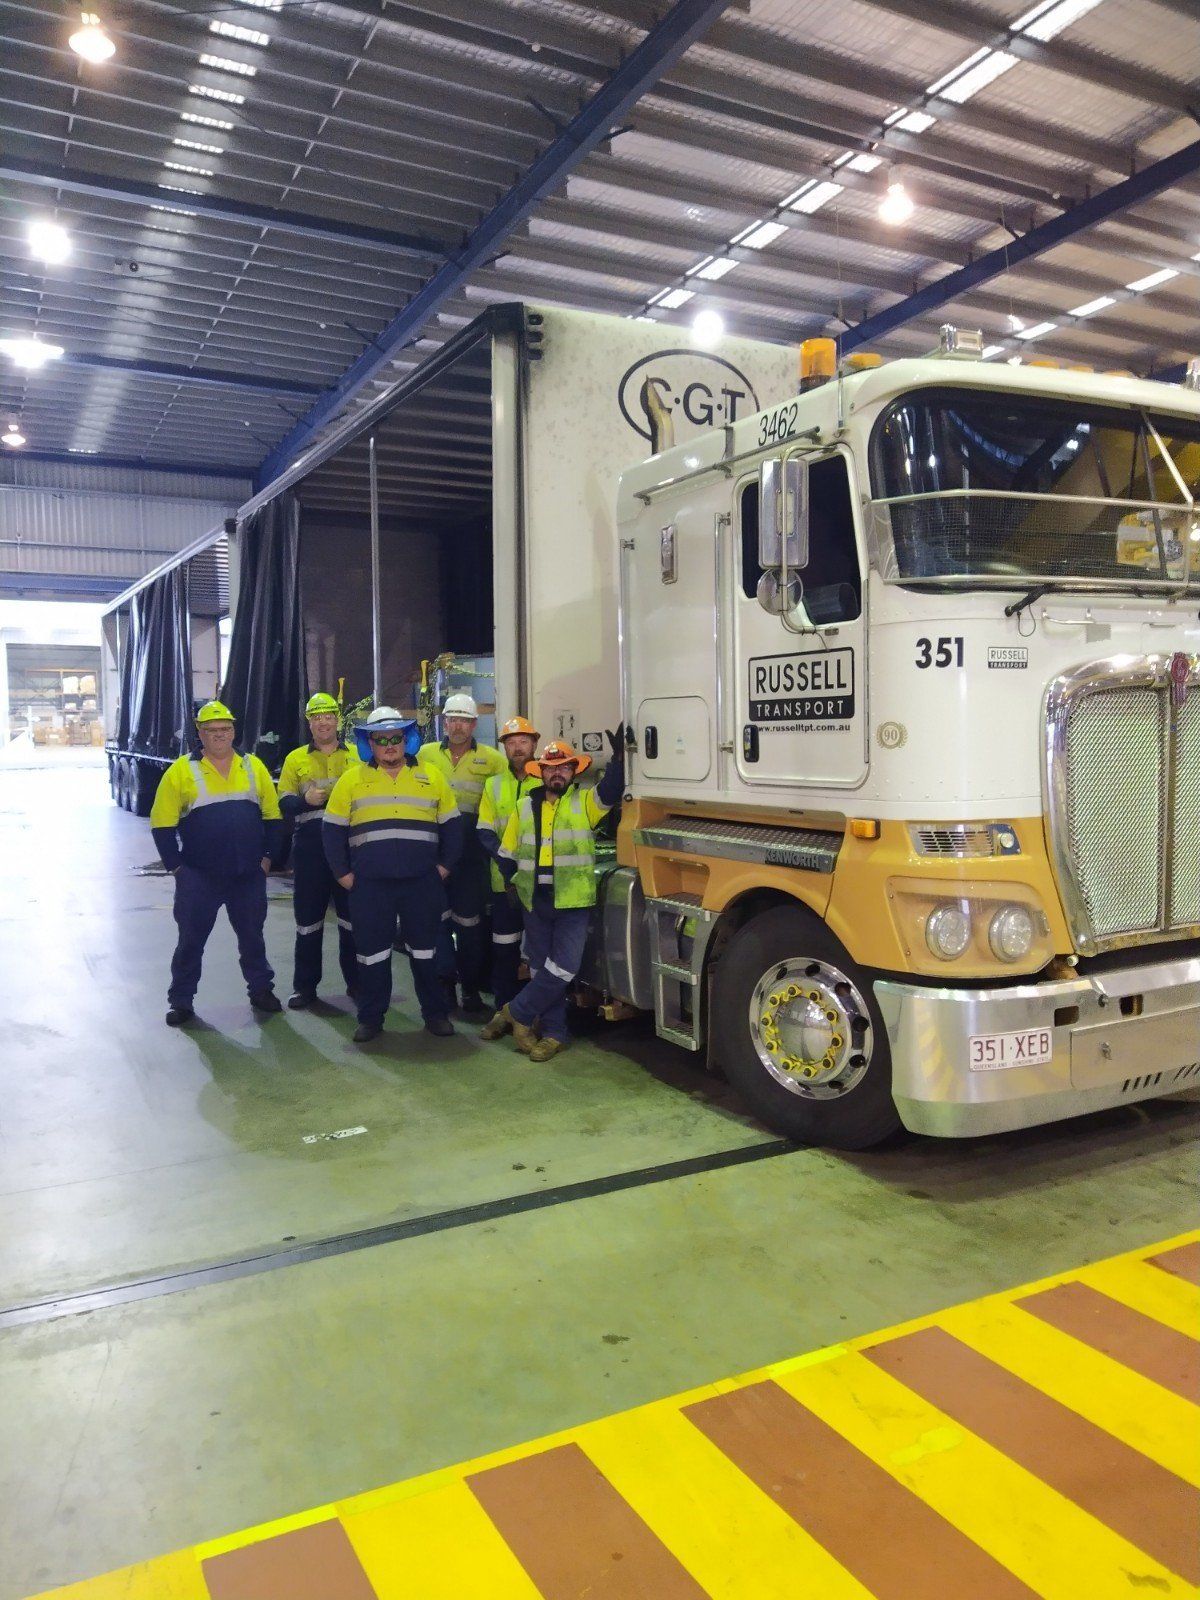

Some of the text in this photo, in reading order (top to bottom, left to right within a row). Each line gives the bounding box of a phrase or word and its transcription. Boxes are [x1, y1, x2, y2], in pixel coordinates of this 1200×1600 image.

[758, 403, 799, 447] 3462
[915, 636, 964, 669] 351
[990, 649, 1026, 660] RUSSELL
[755, 659, 847, 694] RUSSELL
[756, 700, 844, 717] TRANSPORT
[758, 723, 851, 733] ww.russelltpt.com.au
[884, 729, 898, 741] 90
[765, 848, 819, 868] KENWORTH
